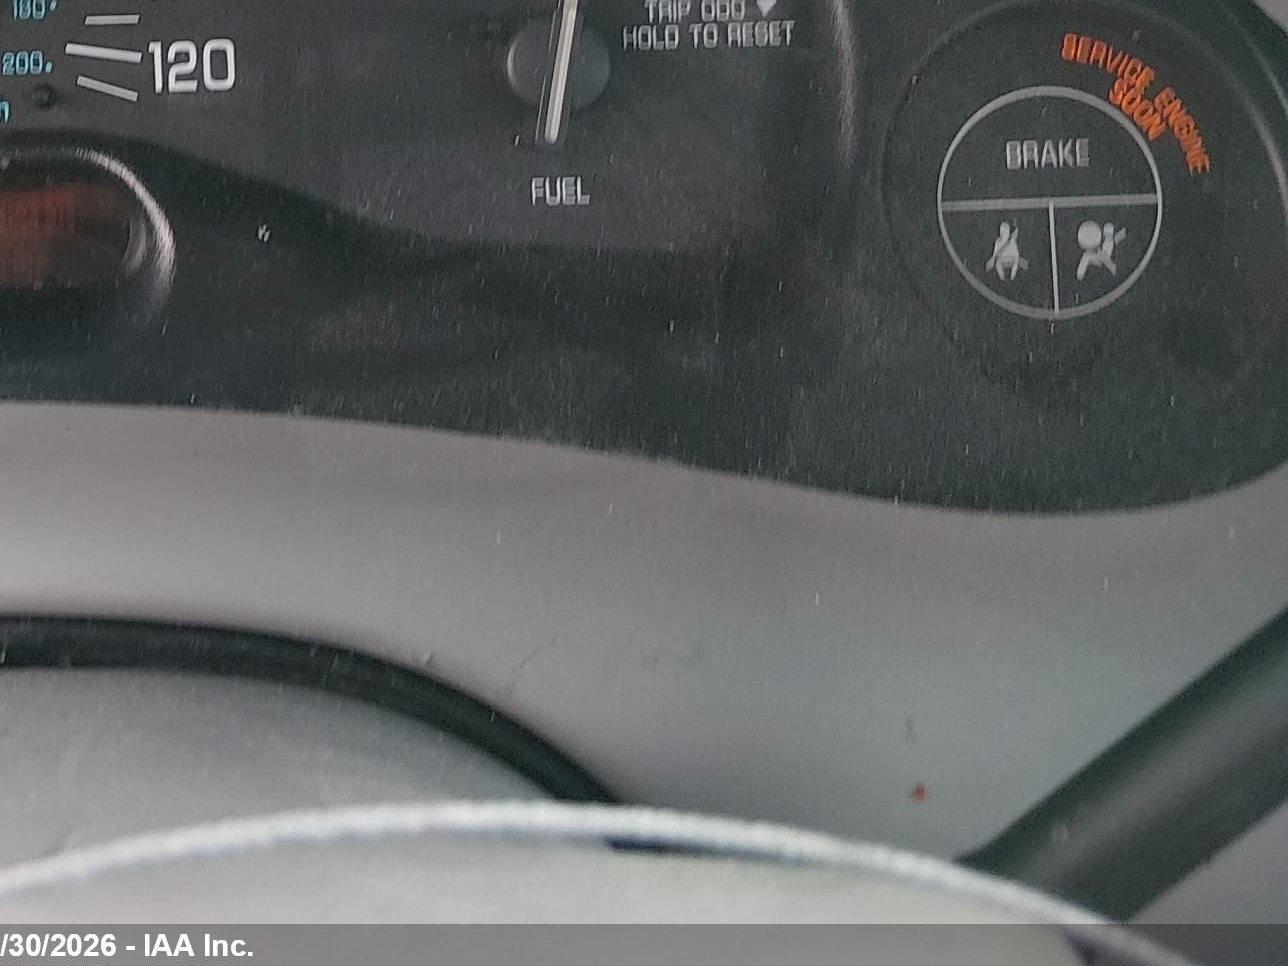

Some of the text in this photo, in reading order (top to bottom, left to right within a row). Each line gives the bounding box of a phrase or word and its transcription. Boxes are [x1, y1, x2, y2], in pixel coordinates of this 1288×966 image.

[622, 20, 796, 51] HOLD TO RESET
[1, 50, 44, 76] 200
[148, 37, 236, 94] 120
[1062, 32, 1210, 176] SERVICE ENGINE
[1109, 78, 1167, 141] SOON
[1005, 137, 1090, 171] BRAKE
[529, 176, 591, 207] FUEL
